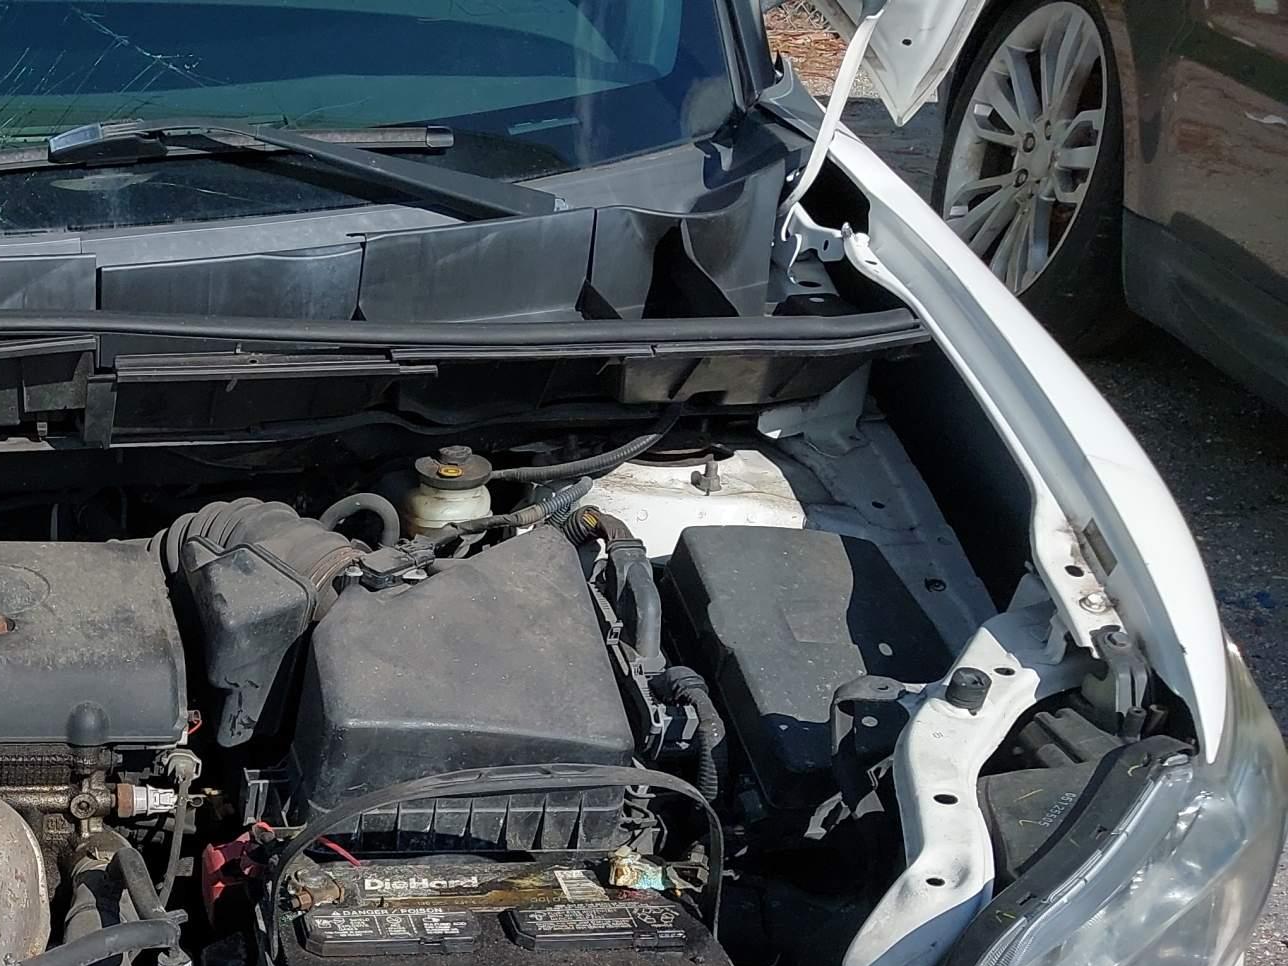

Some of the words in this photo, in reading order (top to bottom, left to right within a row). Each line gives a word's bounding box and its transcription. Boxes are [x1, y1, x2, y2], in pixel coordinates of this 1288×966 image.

[364, 875, 479, 892] DieHard
[342, 908, 389, 917] DANGER
[400, 907, 443, 915] POISON
